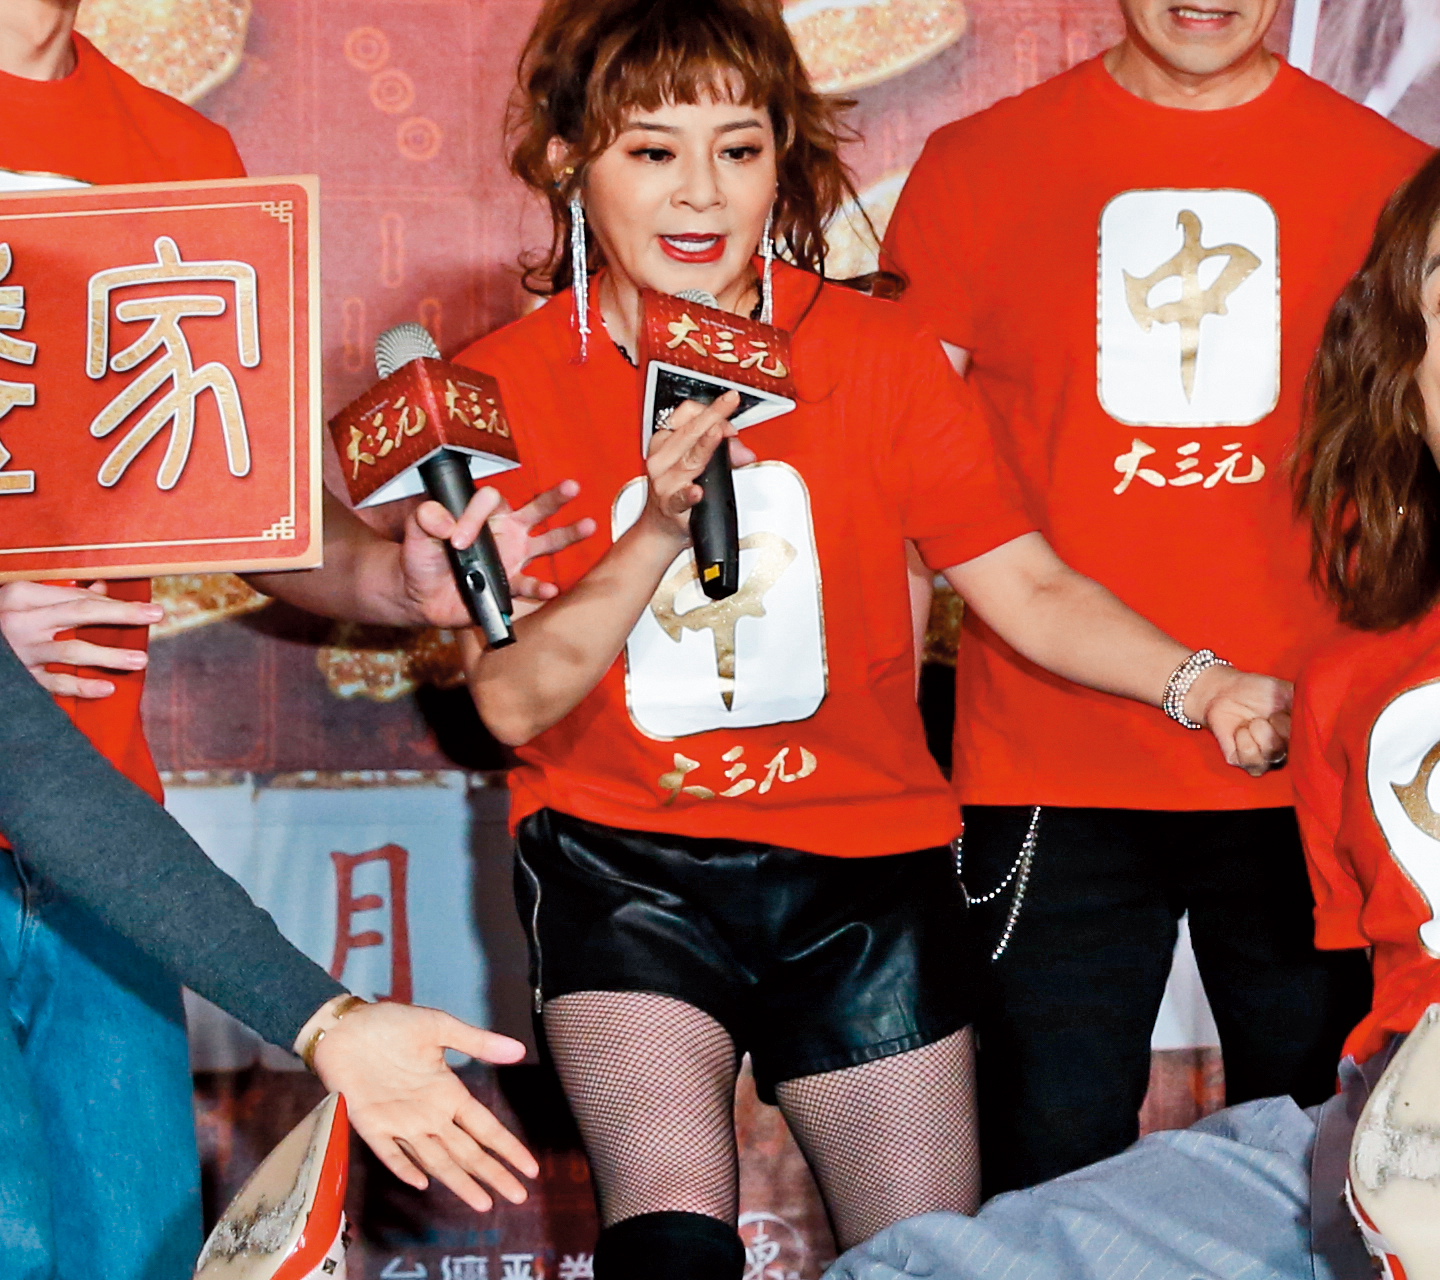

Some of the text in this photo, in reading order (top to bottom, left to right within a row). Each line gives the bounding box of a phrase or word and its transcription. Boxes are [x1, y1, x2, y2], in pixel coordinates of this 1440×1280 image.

[1121, 208, 1263, 406] 中
[665, 312, 789, 379] 大三元
[1112, 438, 1266, 496] 大三元
[658, 745, 818, 805] 大三元
